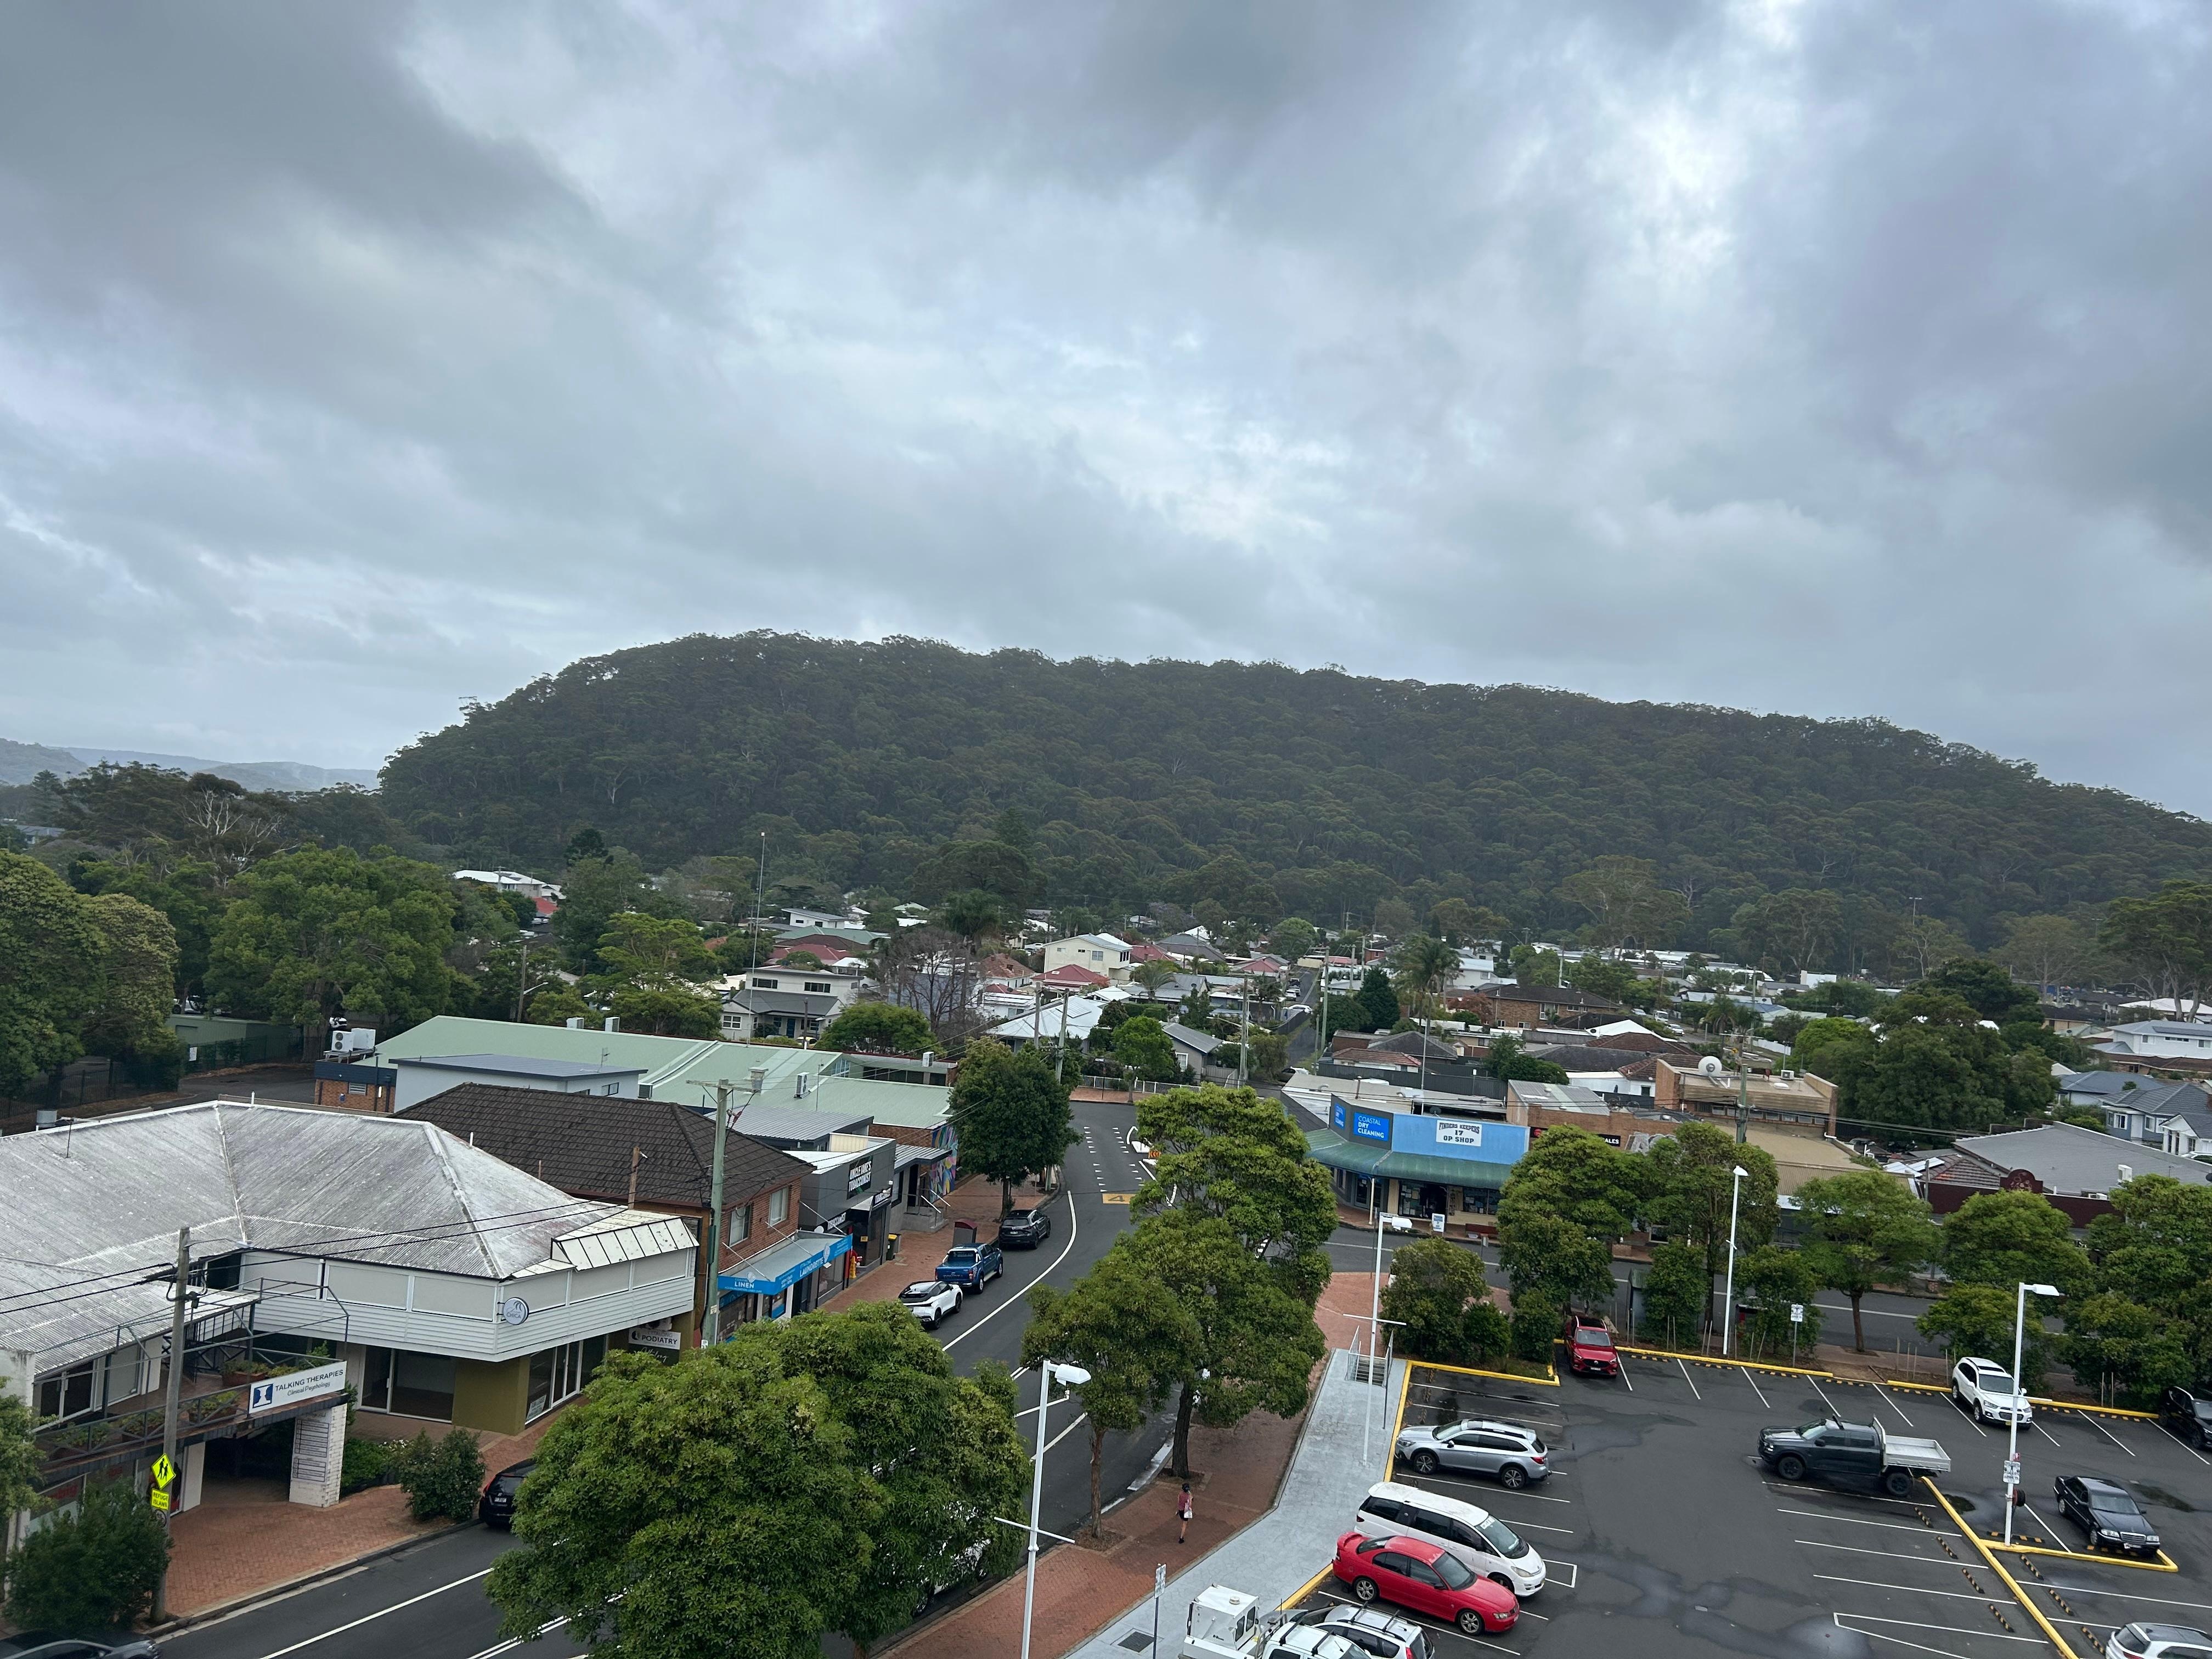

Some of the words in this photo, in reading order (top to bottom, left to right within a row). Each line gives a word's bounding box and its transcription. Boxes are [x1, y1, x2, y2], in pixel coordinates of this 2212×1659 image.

[1358, 1115, 1381, 1126] COASTAL
[1357, 1128, 1384, 1138] CLEANING
[1459, 1125, 1480, 1134] KEEPERS
[799, 1257, 823, 1278] LAUNDRETTE
[641, 1335, 678, 1345] PODIATRY
[275, 1379, 305, 1392] TALKING
[307, 1369, 343, 1384] THERAPIES
[287, 1387, 305, 1396] Clinical
[304, 1381, 330, 1392] Psychology
[153, 1492, 168, 1501] REFUGE
